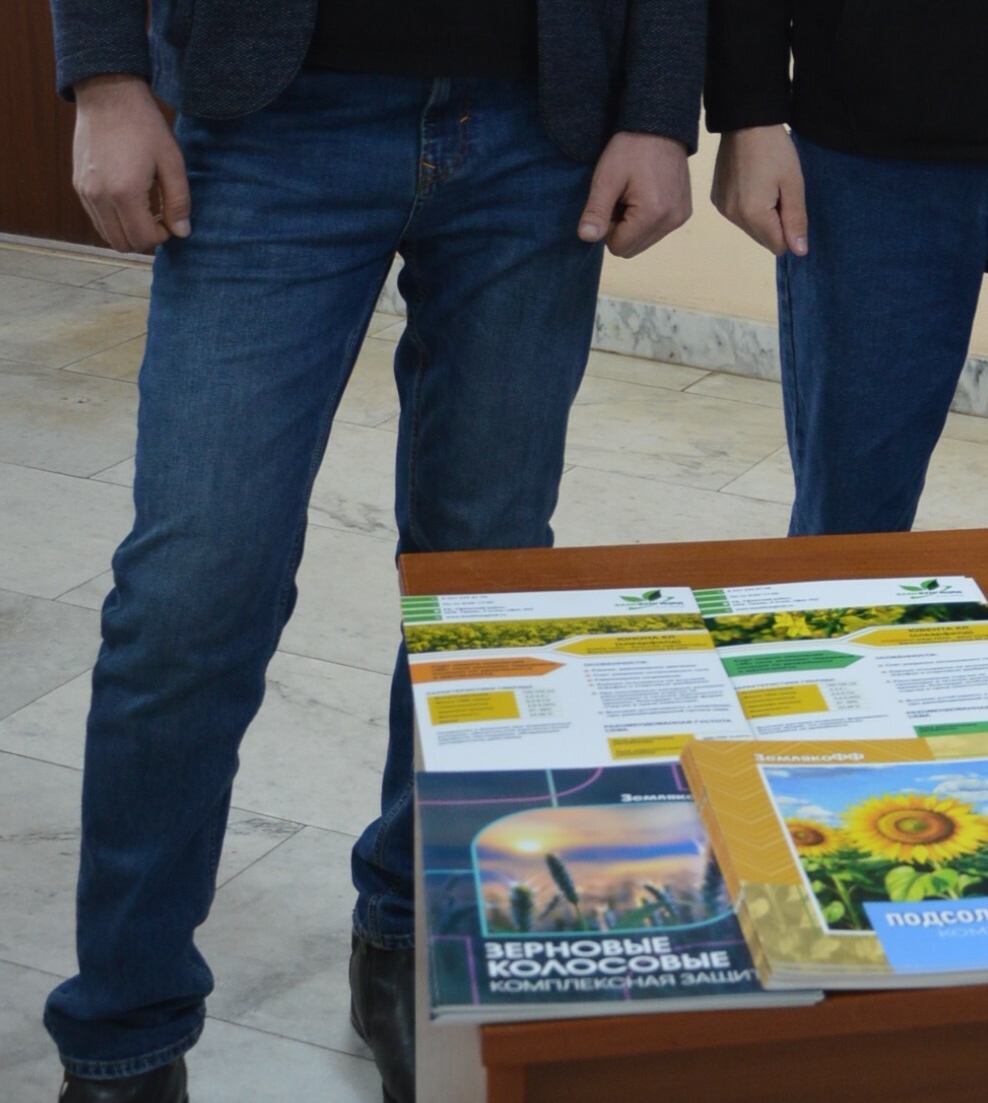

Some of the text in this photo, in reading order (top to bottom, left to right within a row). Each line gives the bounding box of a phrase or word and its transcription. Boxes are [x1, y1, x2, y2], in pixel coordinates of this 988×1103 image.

[484, 936, 672, 960] ЗЕРНОВЫЕ
[488, 950, 731, 978] КОЛОСОВЫЕ
[490, 968, 763, 993] КОМПЛЕКСНАЯ ЗАЩИТ
